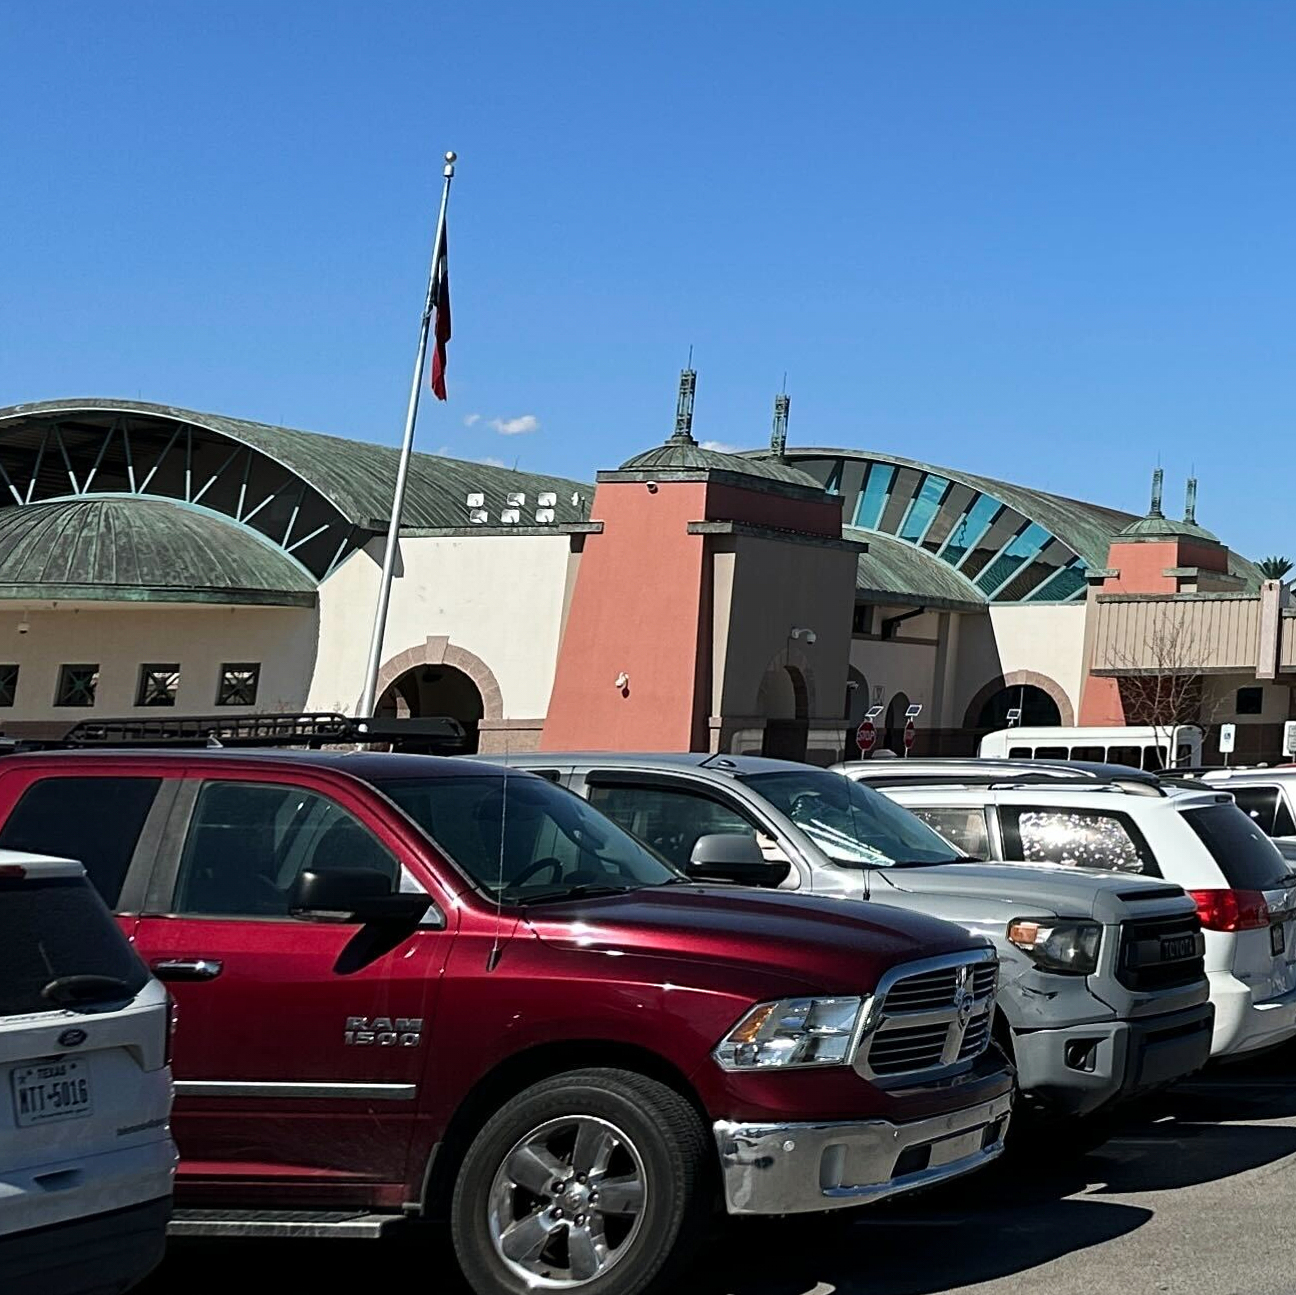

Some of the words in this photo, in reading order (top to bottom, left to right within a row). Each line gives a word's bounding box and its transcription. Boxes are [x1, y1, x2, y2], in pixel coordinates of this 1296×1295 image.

[1164, 937, 1195, 957] TOYOTA
[346, 1016, 423, 1031] RAM
[344, 1031, 420, 1046] 1500
